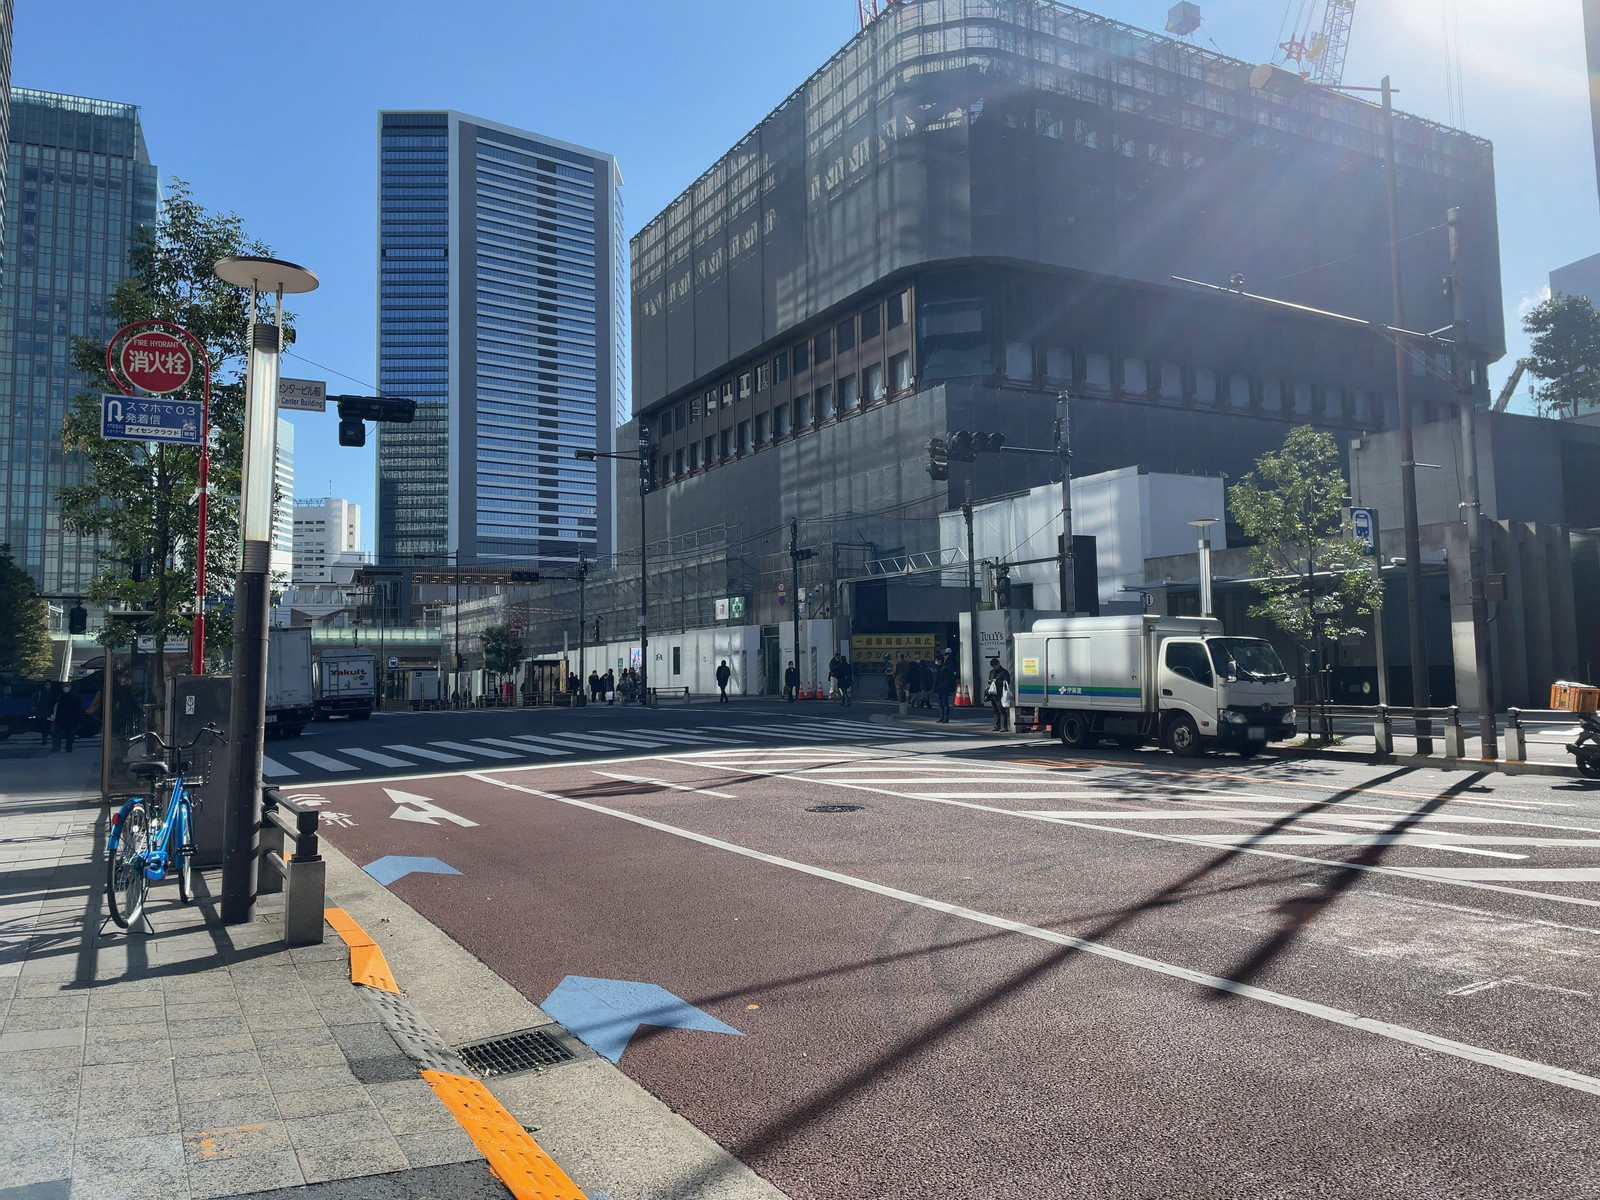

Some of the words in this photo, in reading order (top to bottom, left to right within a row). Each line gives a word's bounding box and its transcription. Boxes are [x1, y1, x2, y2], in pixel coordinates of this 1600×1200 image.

[150, 340, 179, 348] HYDRANT
[129, 350, 186, 375] 消火栓
[281, 397, 299, 405] Center
[301, 399, 322, 408] Building
[125, 413, 161, 425] 発着信
[128, 426, 179, 436] ナイセンクラウド
